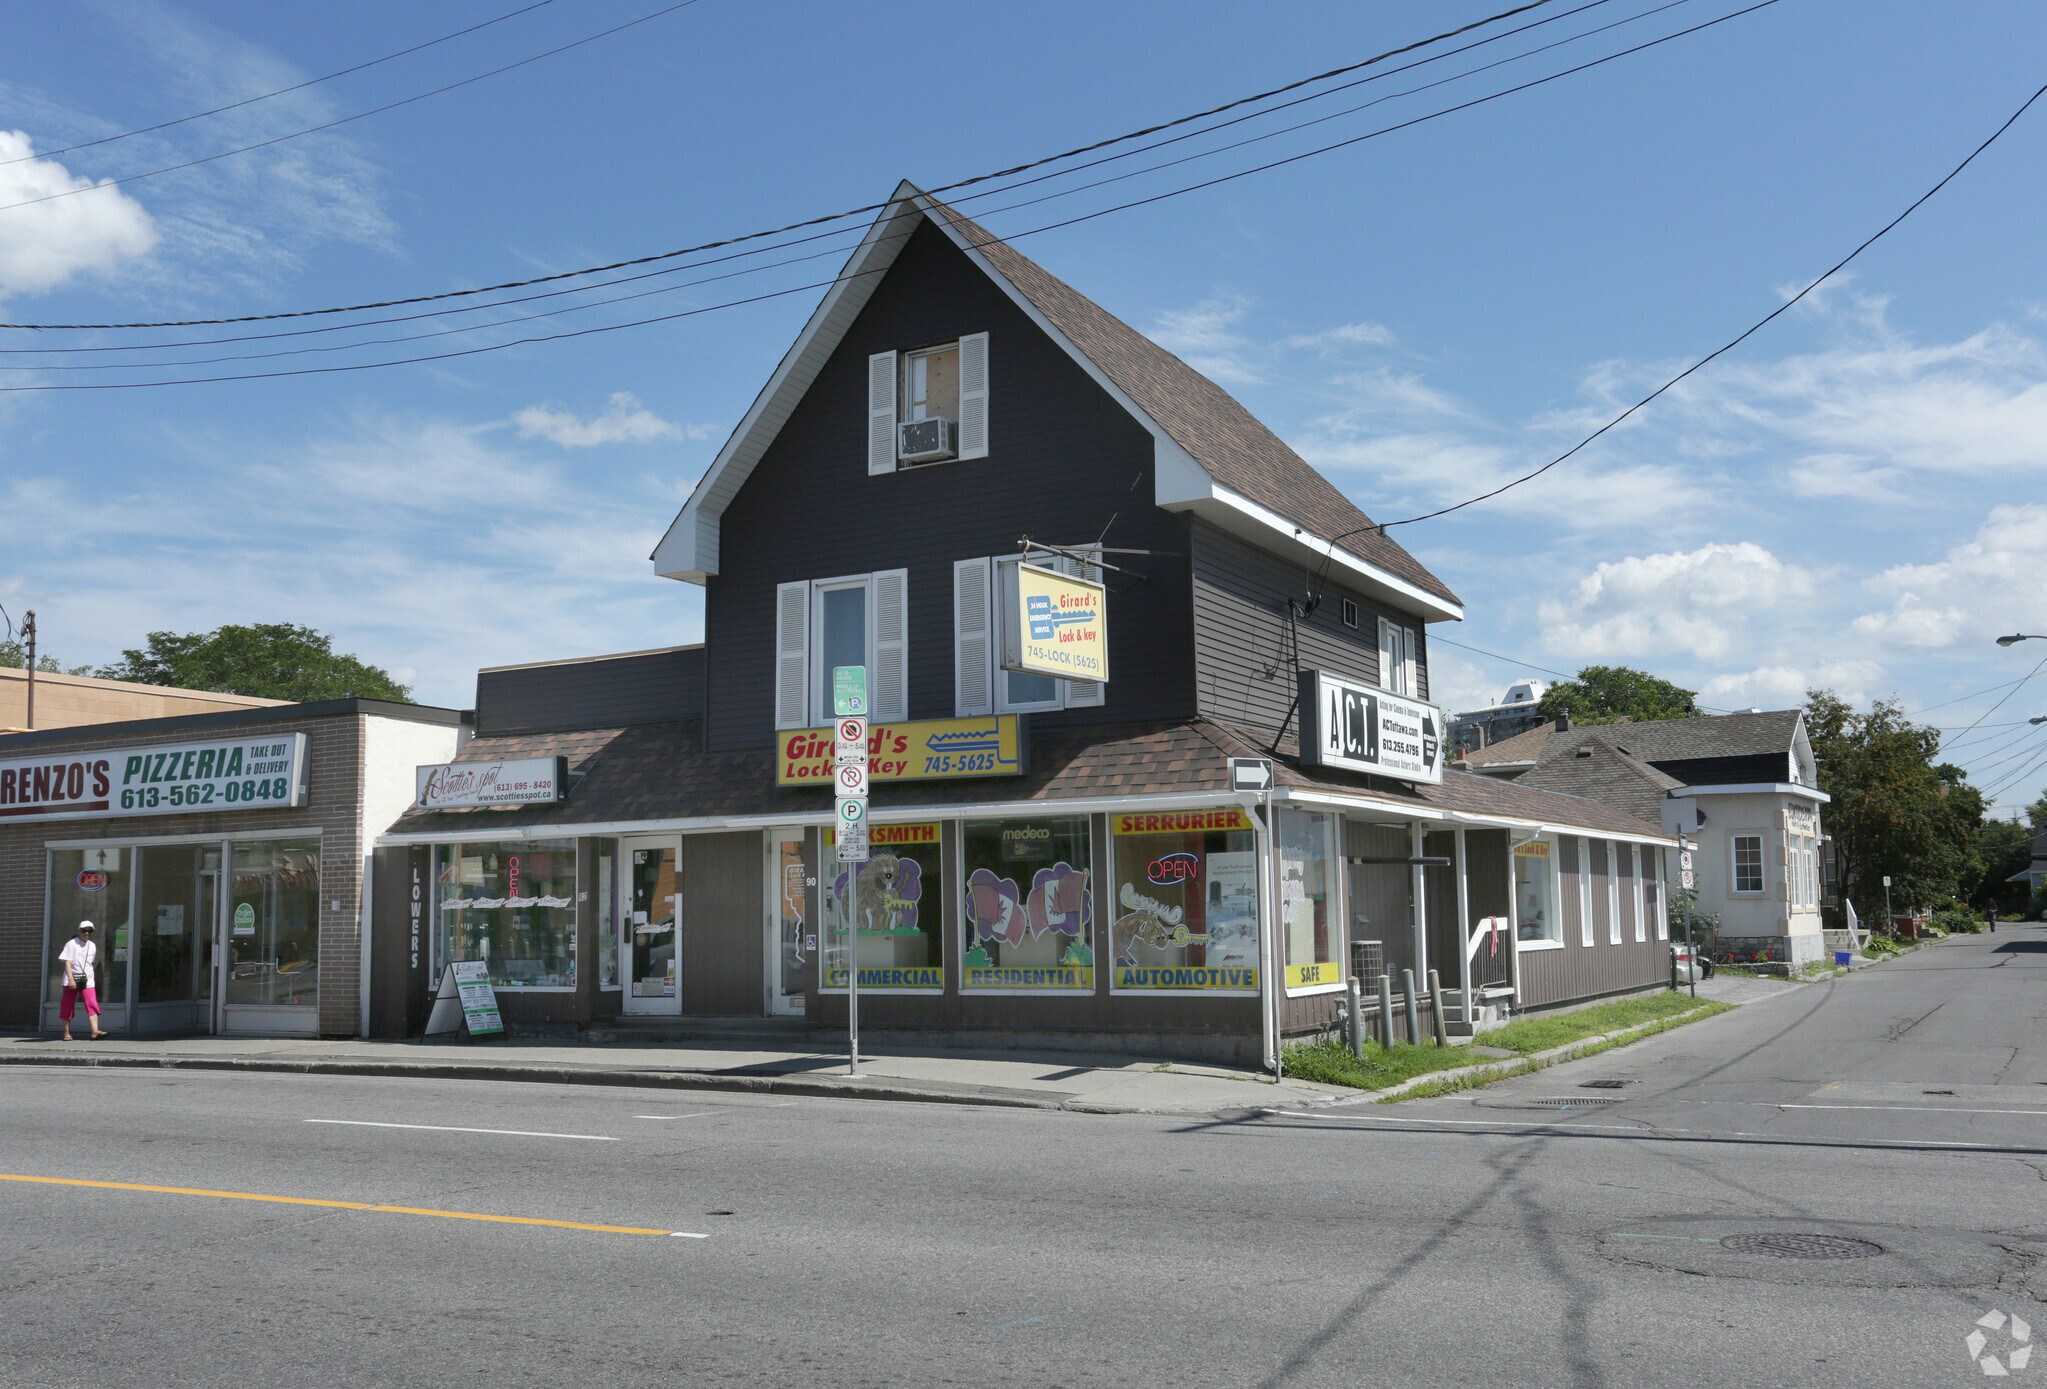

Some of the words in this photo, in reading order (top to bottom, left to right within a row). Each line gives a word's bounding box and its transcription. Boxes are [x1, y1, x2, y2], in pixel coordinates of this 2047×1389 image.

[1060, 592, 1097, 608] Girard's
[1059, 629, 1075, 643] Lock
[1076, 628, 1082, 641] &
[1084, 627, 1097, 642] key
[1028, 645, 1071, 664] 745-LOCK
[1073, 654, 1100, 672] (5625)
[1382, 718, 1419, 737] ACTottawa.com
[250, 745, 268, 759] TAKE
[271, 744, 287, 757] OUT
[786, 728, 908, 759] Gird's
[1382, 738, 1419, 756] 613.255.4796
[122, 746, 243, 785] PIZZERIA
[245, 764, 252, 775] &
[253, 760, 289, 775] DELIVERY
[786, 760, 833, 778] Lock
[868, 758, 909, 776] Key
[924, 753, 995, 774] 745-5625
[0, 760, 110, 804] RENZO'S
[476, 762, 503, 799] spot
[494, 783, 513, 792] (613)
[514, 782, 528, 790] 695
[533, 780, 552, 789] 8420
[120, 777, 288, 809] 613-562-0848
[478, 790, 552, 802] www.scottiesspot.ca
[1121, 811, 1241, 832] SERRURIER
[1003, 824, 1050, 840] medeco
[509, 856, 519, 899] OPEN
[1147, 860, 1199, 879] OPEN
[80, 873, 106, 886] OPEN
[806, 877, 816, 886] 90
[830, 970, 940, 986] COMMERCIAL
[971, 970, 1087, 986] RESIDENTIAL
[1122, 969, 1253, 986] AUTOMOTIVE
[1300, 965, 1320, 983] SAFE
